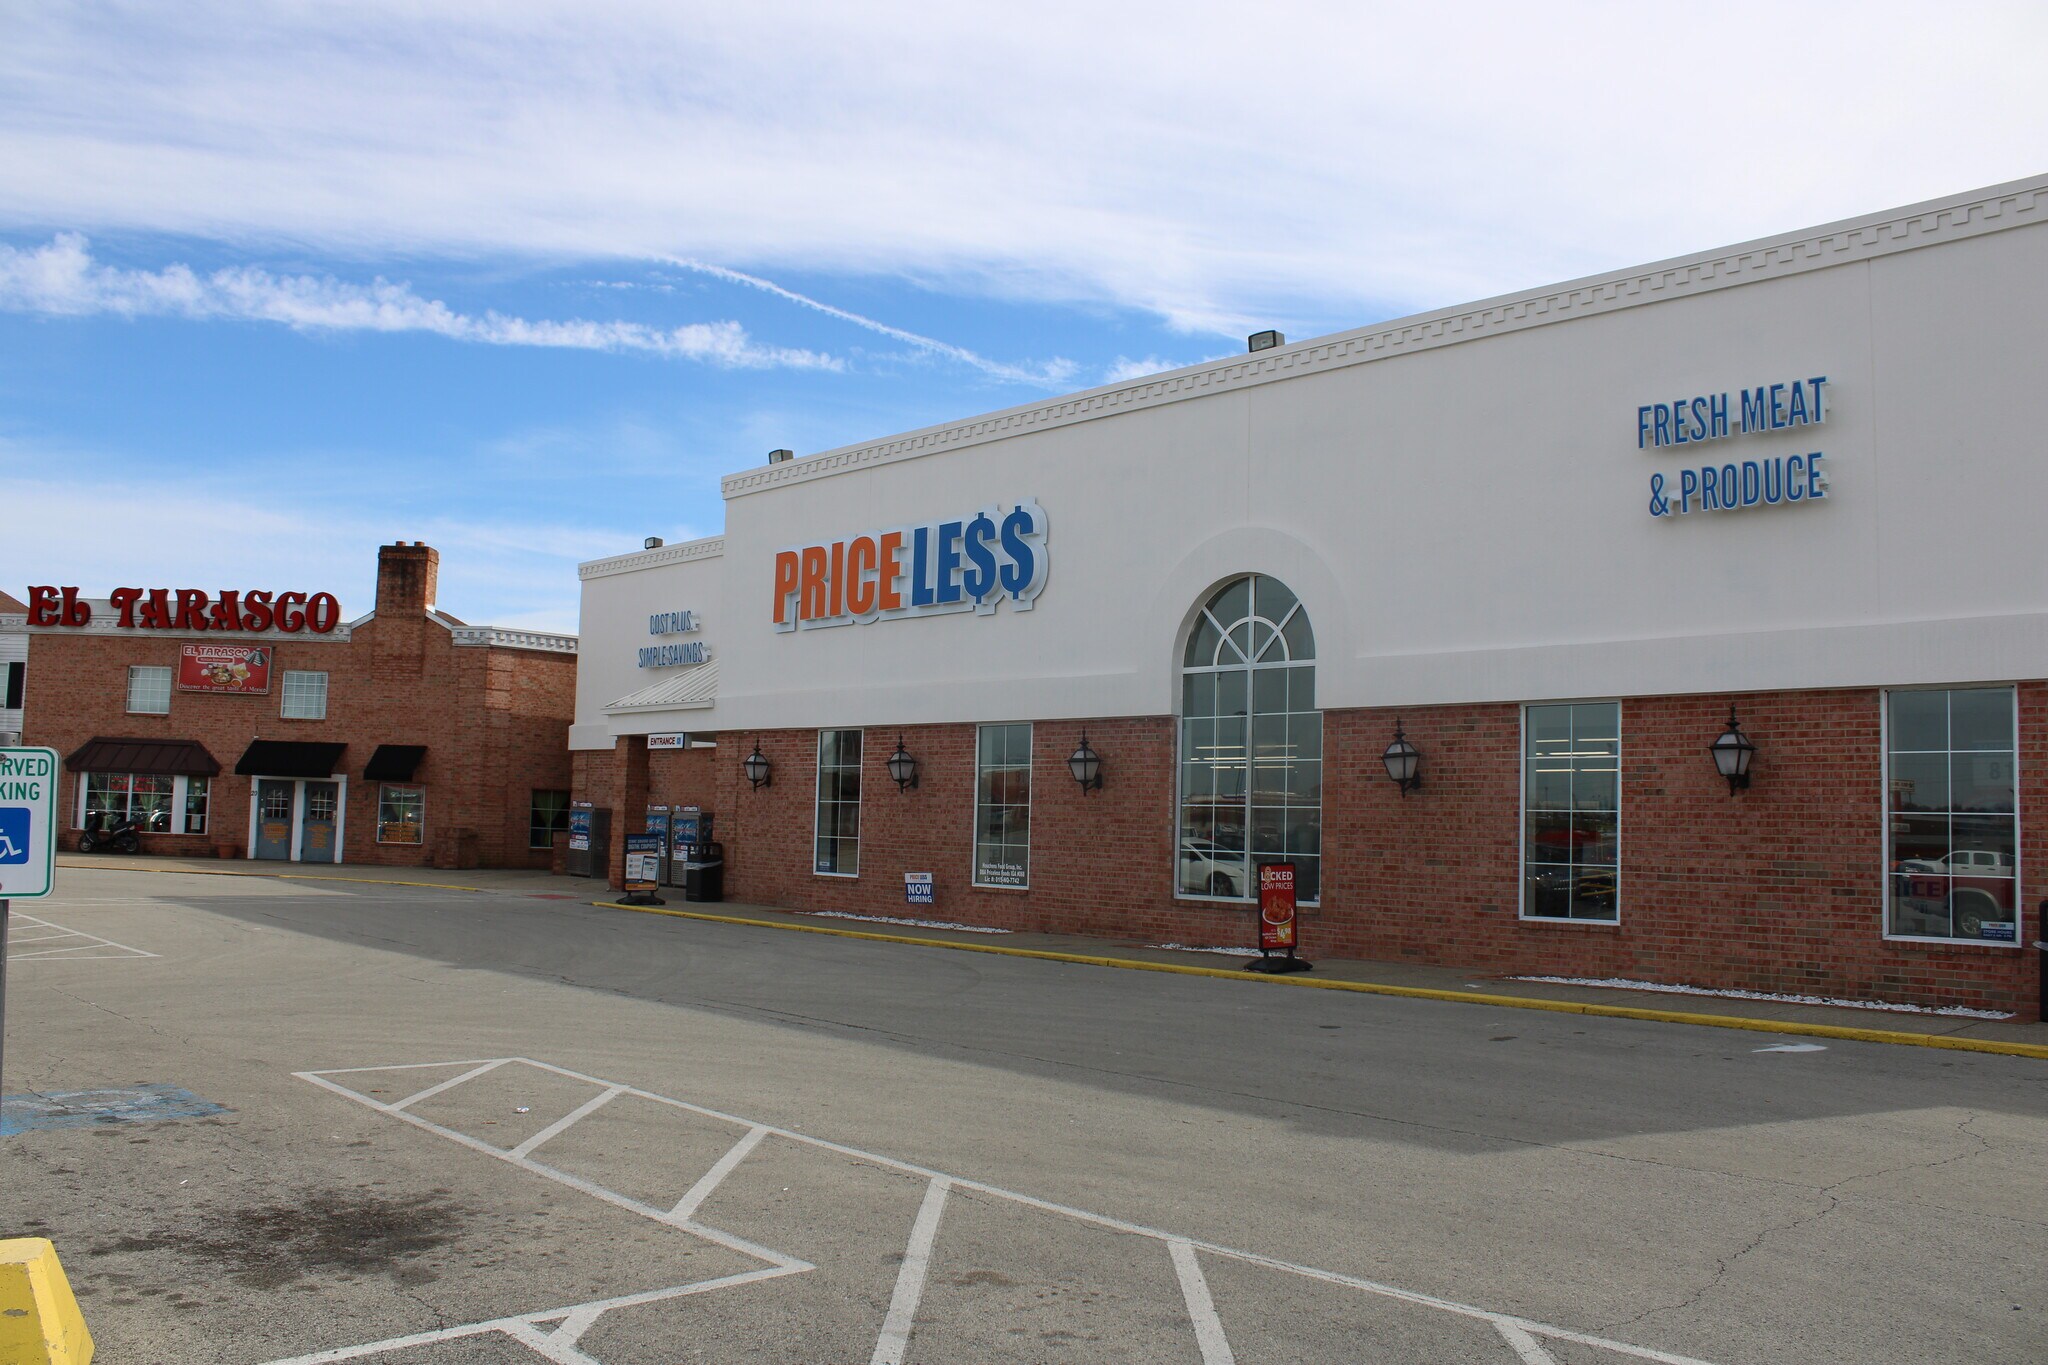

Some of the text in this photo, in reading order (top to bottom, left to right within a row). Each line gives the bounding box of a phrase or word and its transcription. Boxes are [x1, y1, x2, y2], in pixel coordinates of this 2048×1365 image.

[1638, 376, 1827, 449] FRESH MEAT
[1649, 452, 1824, 517] & PRODUCE
[27, 585, 341, 634] EL TARASCO
[649, 613, 670, 635] COST
[183, 646, 249, 657] EL TARASCO
[638, 641, 703, 668] SIMPLE SAVINGS
[650, 736, 676, 746] ENTRANCE
[907, 883, 931, 894] NOW
[1261, 882, 1294, 890] LOW PRICES
[908, 894, 932, 903] HIRING
